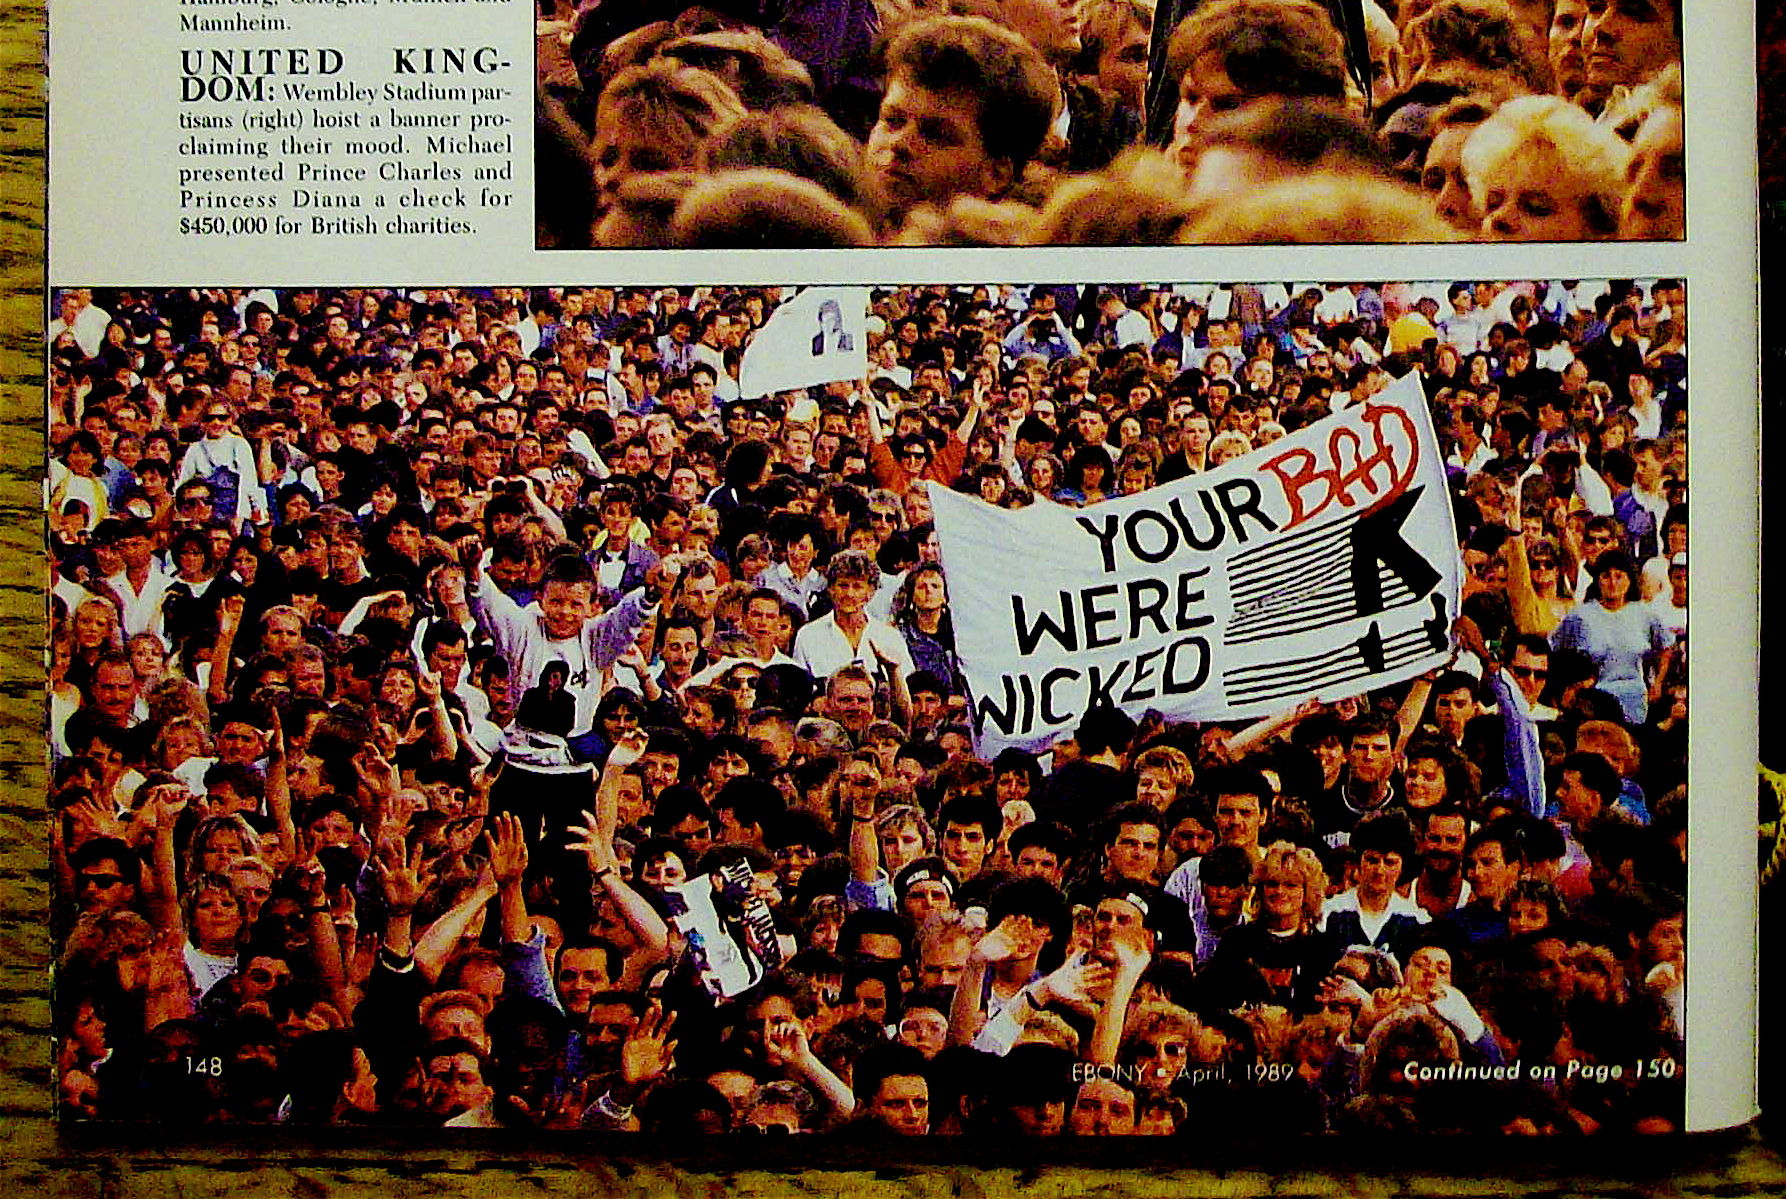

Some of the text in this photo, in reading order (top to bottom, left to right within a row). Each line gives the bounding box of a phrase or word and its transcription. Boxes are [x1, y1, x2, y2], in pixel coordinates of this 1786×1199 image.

[179, 11, 291, 32] Mannheim.
[179, 48, 344, 76] UNITED
[179, 75, 275, 103] DOM:
[282, 81, 378, 103] Wembley
[383, 80, 466, 101] Stadium
[179, 111, 233, 130] tisans
[242, 107, 303, 134] (right)
[312, 107, 361, 129] hoist
[369, 114, 381, 128] a
[390, 107, 461, 128] banner
[178, 133, 512, 160] claiming their mood. Michael
[179, 160, 512, 187] presented Prince Charles and
[180, 186, 513, 209] Princess Diana a check for
[179, 213, 477, 238] $450,000 for British charities.
[1076, 404, 1421, 573] YOUR BAD
[1010, 565, 1215, 657] WERE
[964, 636, 1211, 737] WICKED
[186, 1056, 222, 1077] 148
[1072, 1062, 1294, 1086] EBONY April, 1989
[1403, 1057, 1676, 1084] Continued on Page 150
